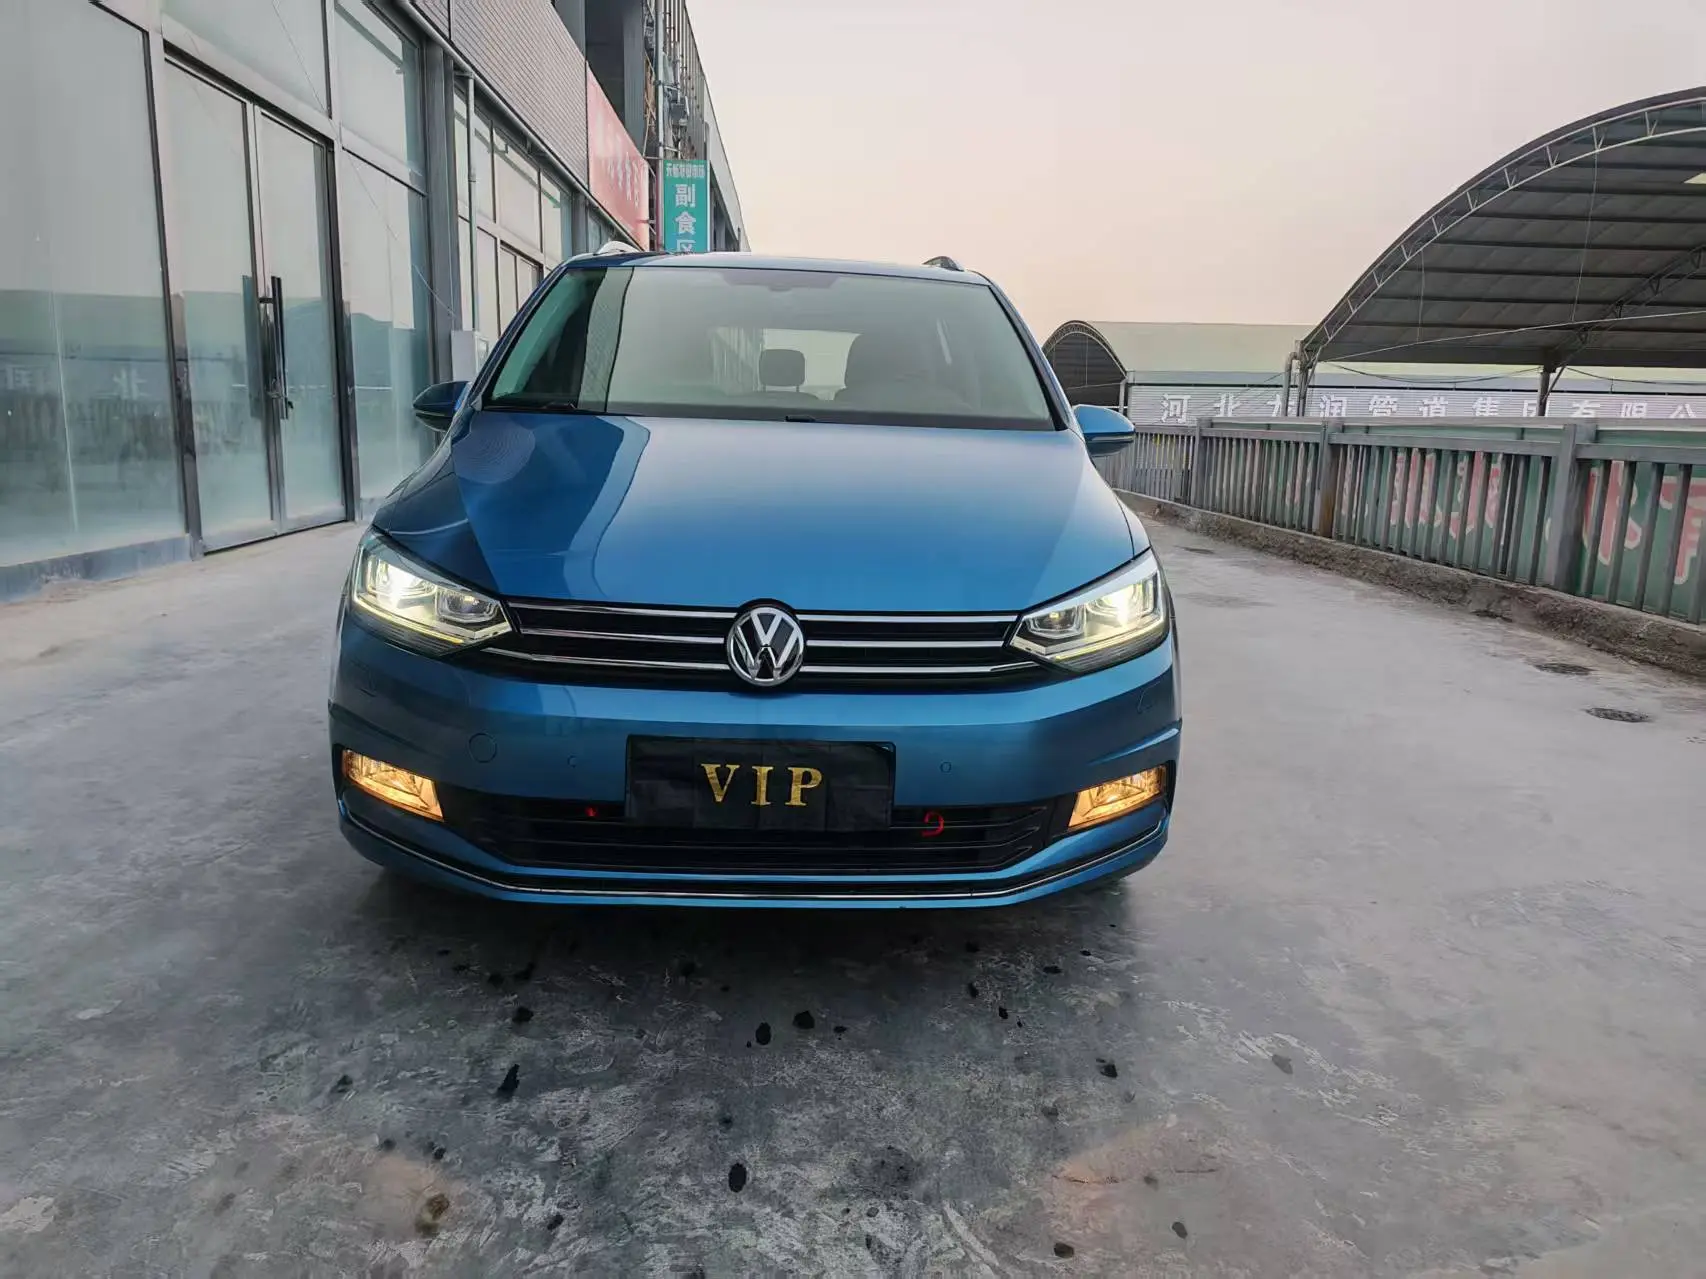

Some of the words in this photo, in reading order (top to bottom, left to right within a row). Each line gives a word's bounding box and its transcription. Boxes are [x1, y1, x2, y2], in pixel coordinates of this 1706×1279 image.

[675, 183, 697, 253] 副食区
[700, 763, 822, 806] VIP
